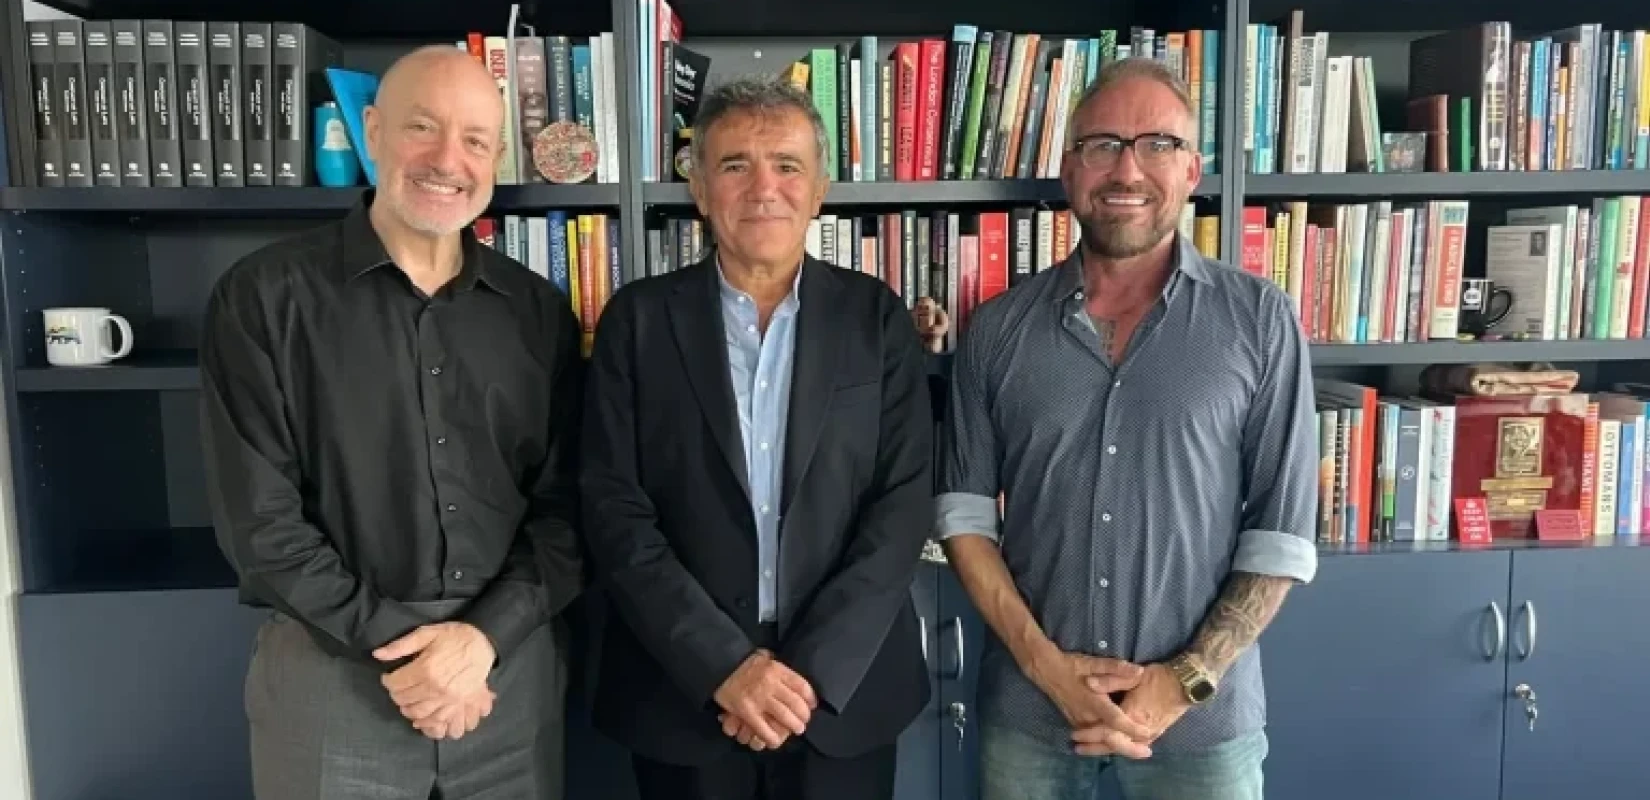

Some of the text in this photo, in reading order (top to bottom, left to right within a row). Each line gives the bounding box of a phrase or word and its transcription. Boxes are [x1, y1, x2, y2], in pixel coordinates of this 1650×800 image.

[924, 44, 942, 166] The London Consensus
[1446, 236, 1460, 277] RADICAL
[1444, 279, 1455, 304] FUND
[1582, 452, 1594, 494] SHAME
[1601, 432, 1615, 512] OTTOMANS
